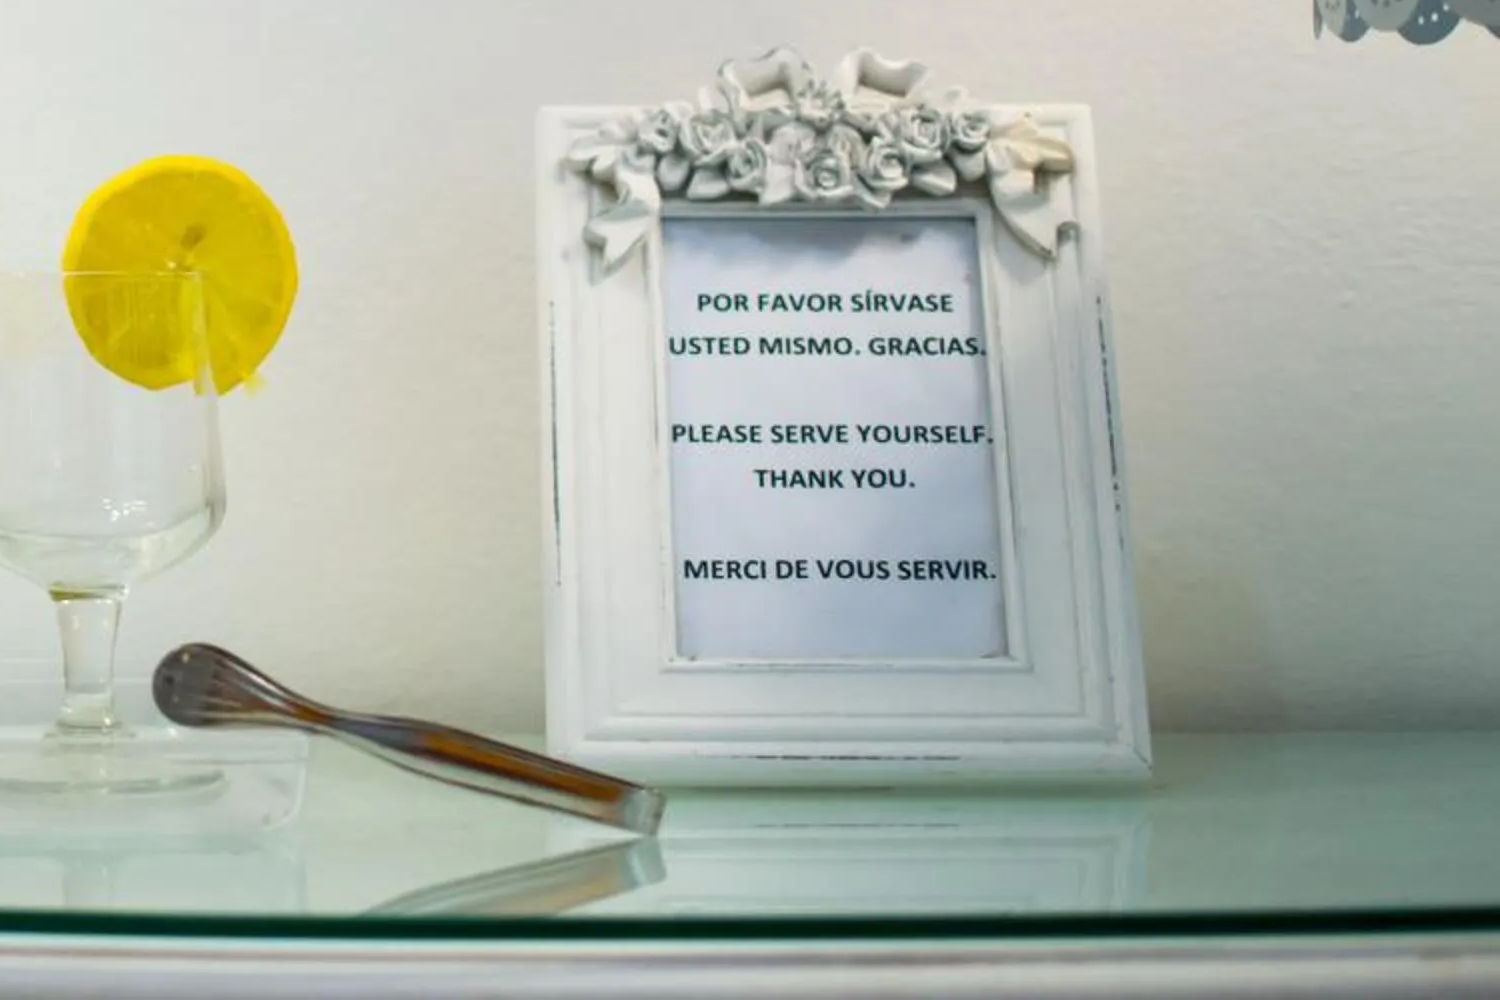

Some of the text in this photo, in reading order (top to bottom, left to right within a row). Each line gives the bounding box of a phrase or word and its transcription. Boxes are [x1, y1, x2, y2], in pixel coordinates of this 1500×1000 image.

[696, 289, 954, 313] POR FAVOR SÍRVASE
[668, 336, 988, 357] USTED MISMO. GRACIAS.
[671, 424, 995, 445] PLEASE SERVE YOURSELF.
[753, 468, 916, 489] THANK YOU.
[682, 558, 998, 581] MERCI DE VOUS SERVIR.
